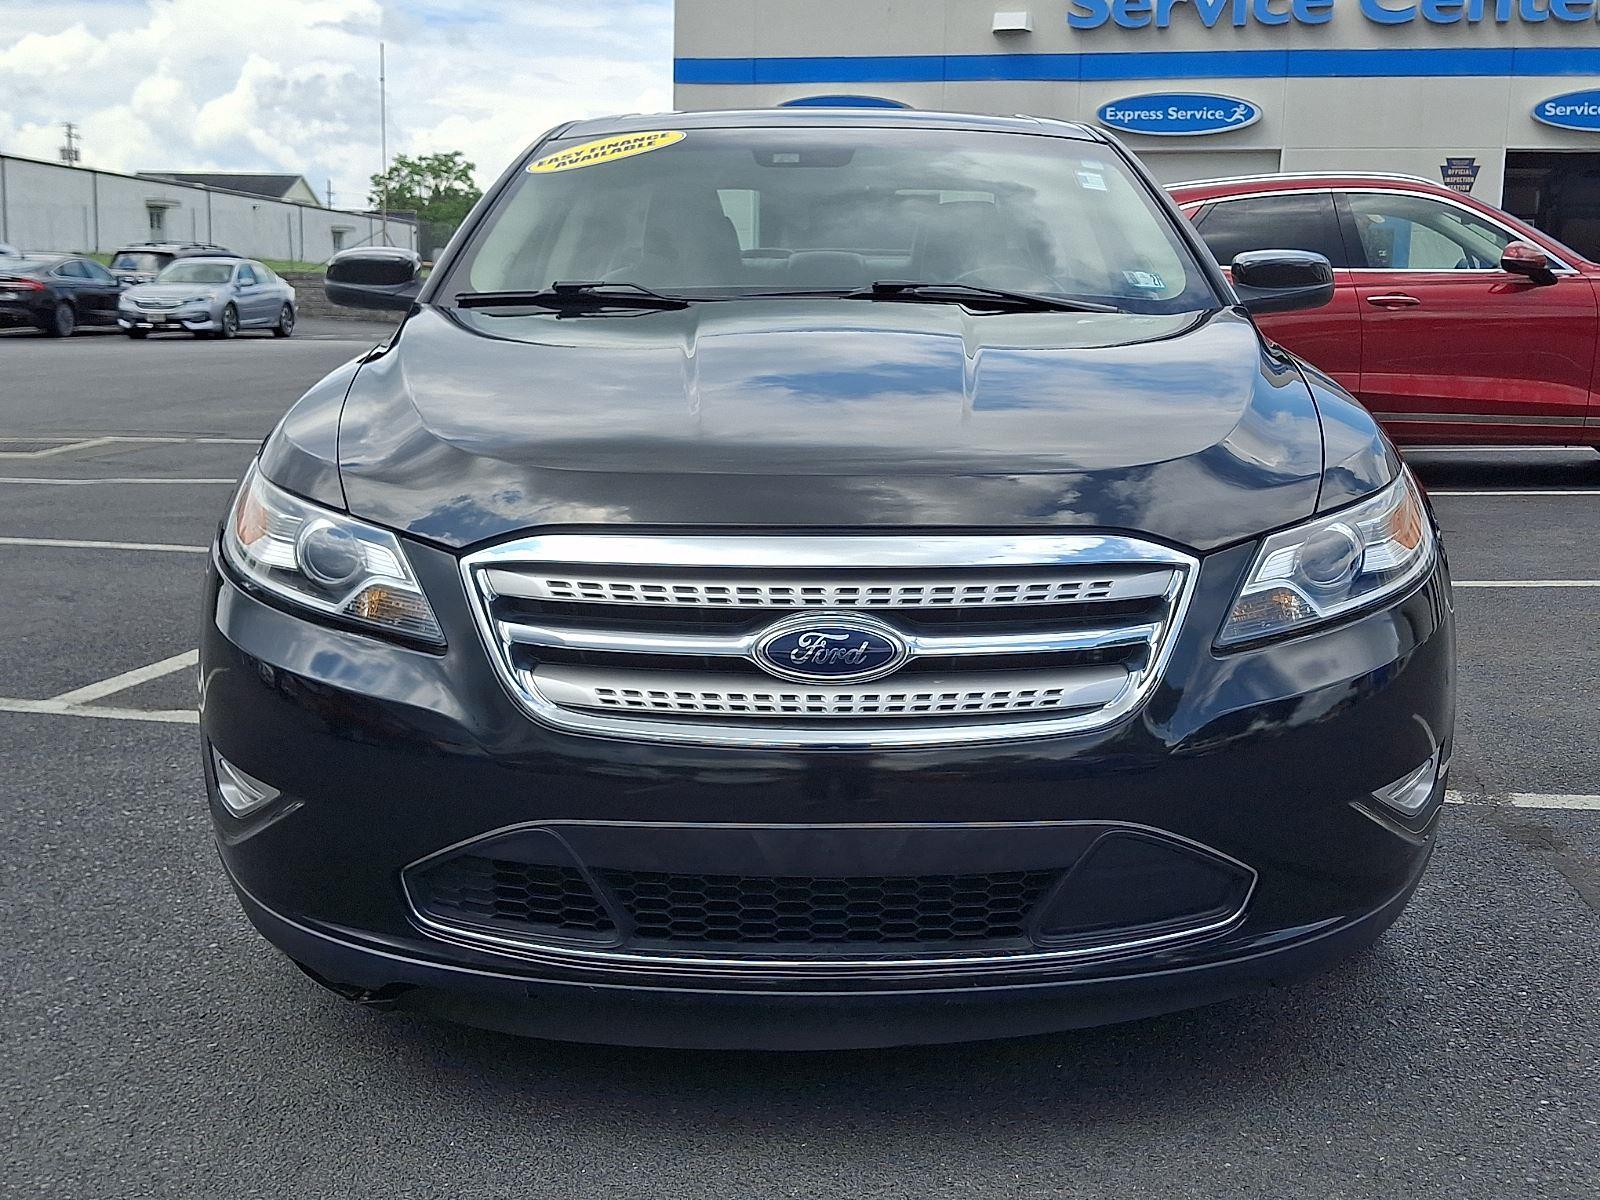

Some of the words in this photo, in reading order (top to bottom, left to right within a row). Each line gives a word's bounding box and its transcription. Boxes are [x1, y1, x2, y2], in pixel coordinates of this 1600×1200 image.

[1360, 0, 1600, 25] Cente
[1105, 107, 1164, 123] Express
[1167, 107, 1225, 120] Service
[1544, 102, 1600, 116] Servic
[537, 149, 585, 168] EASY
[590, 132, 671, 152] FINANCE
[554, 140, 658, 169] AVAILABLE
[790, 631, 869, 665] Ford
